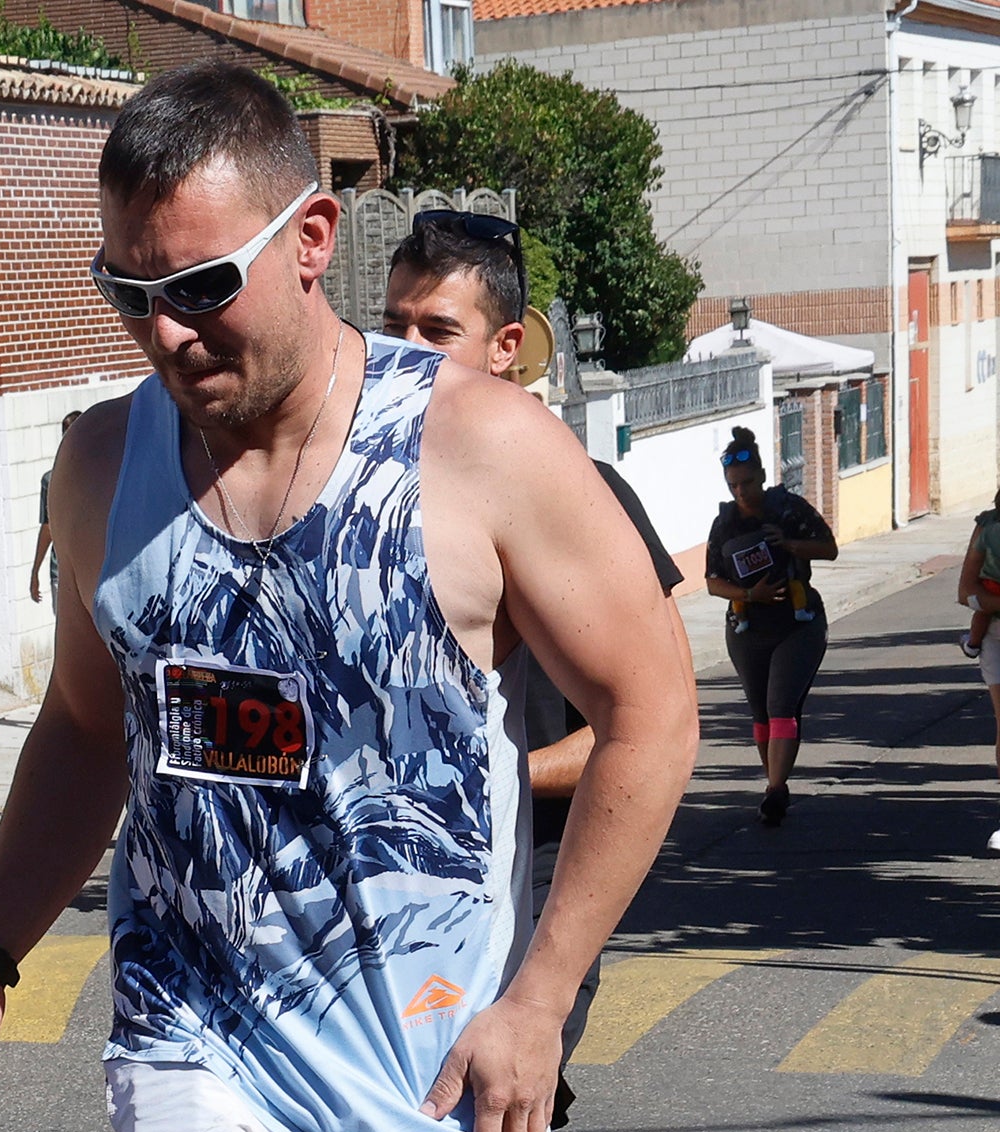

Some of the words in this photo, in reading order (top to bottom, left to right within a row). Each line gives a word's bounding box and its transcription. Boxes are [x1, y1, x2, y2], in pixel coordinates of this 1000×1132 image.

[181, 706, 192, 718] de
[210, 697, 304, 753] 198
[192, 738, 203, 767] Fatiga
